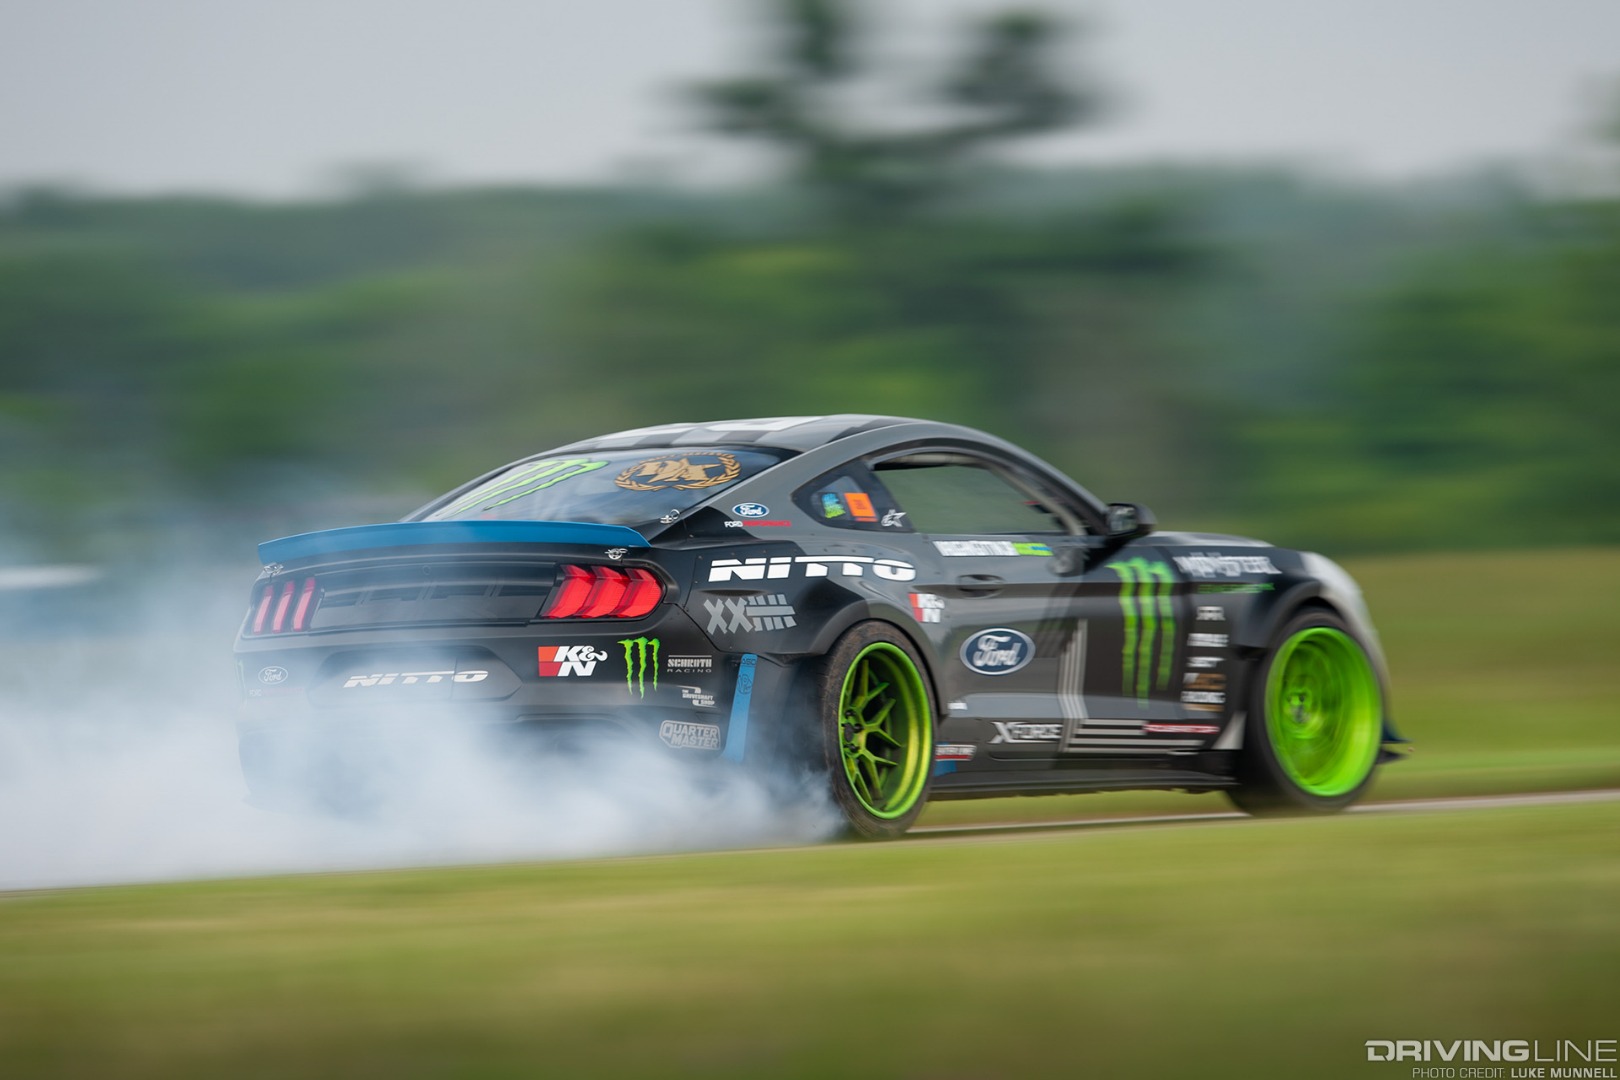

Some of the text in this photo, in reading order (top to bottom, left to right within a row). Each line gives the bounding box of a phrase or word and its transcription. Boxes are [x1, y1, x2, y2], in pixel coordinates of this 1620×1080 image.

[739, 504, 764, 515] Ford
[708, 555, 916, 582] NITTO
[973, 634, 1022, 667] Ford
[667, 658, 712, 668] SCHROTH
[264, 669, 282, 681] Ford
[343, 670, 489, 688] NITTO
[661, 723, 718, 738] QUARTER
[671, 733, 719, 749] MASTER
